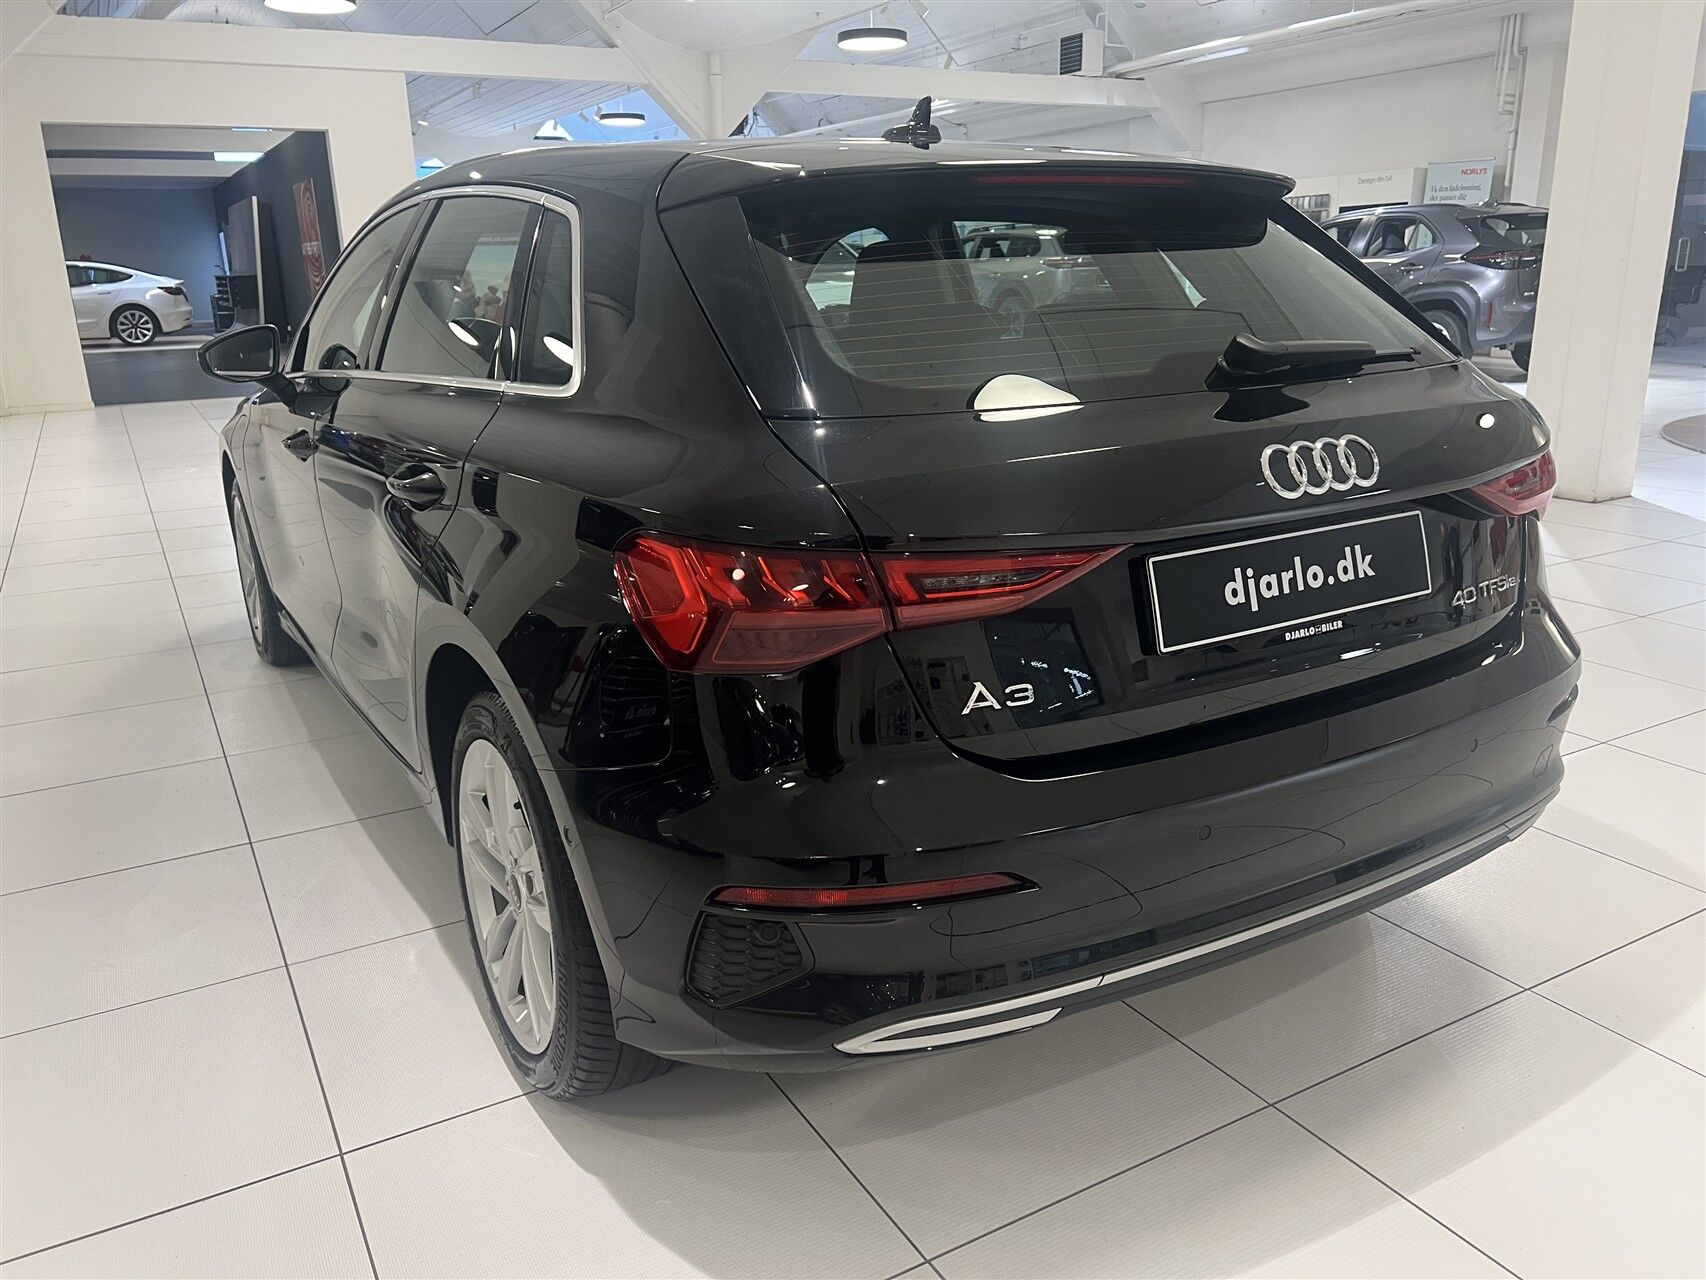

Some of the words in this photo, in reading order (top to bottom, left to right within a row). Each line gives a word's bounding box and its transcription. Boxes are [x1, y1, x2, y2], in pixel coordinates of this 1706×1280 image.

[1357, 177, 1377, 185] Design
[1460, 168, 1488, 176] NORLYS
[1223, 544, 1376, 612] djarlo.dk
[1452, 586, 1477, 610] 40
[1285, 626, 1316, 641] DJARLO
[1321, 620, 1343, 633] BILER
[961, 681, 1035, 715] A3
